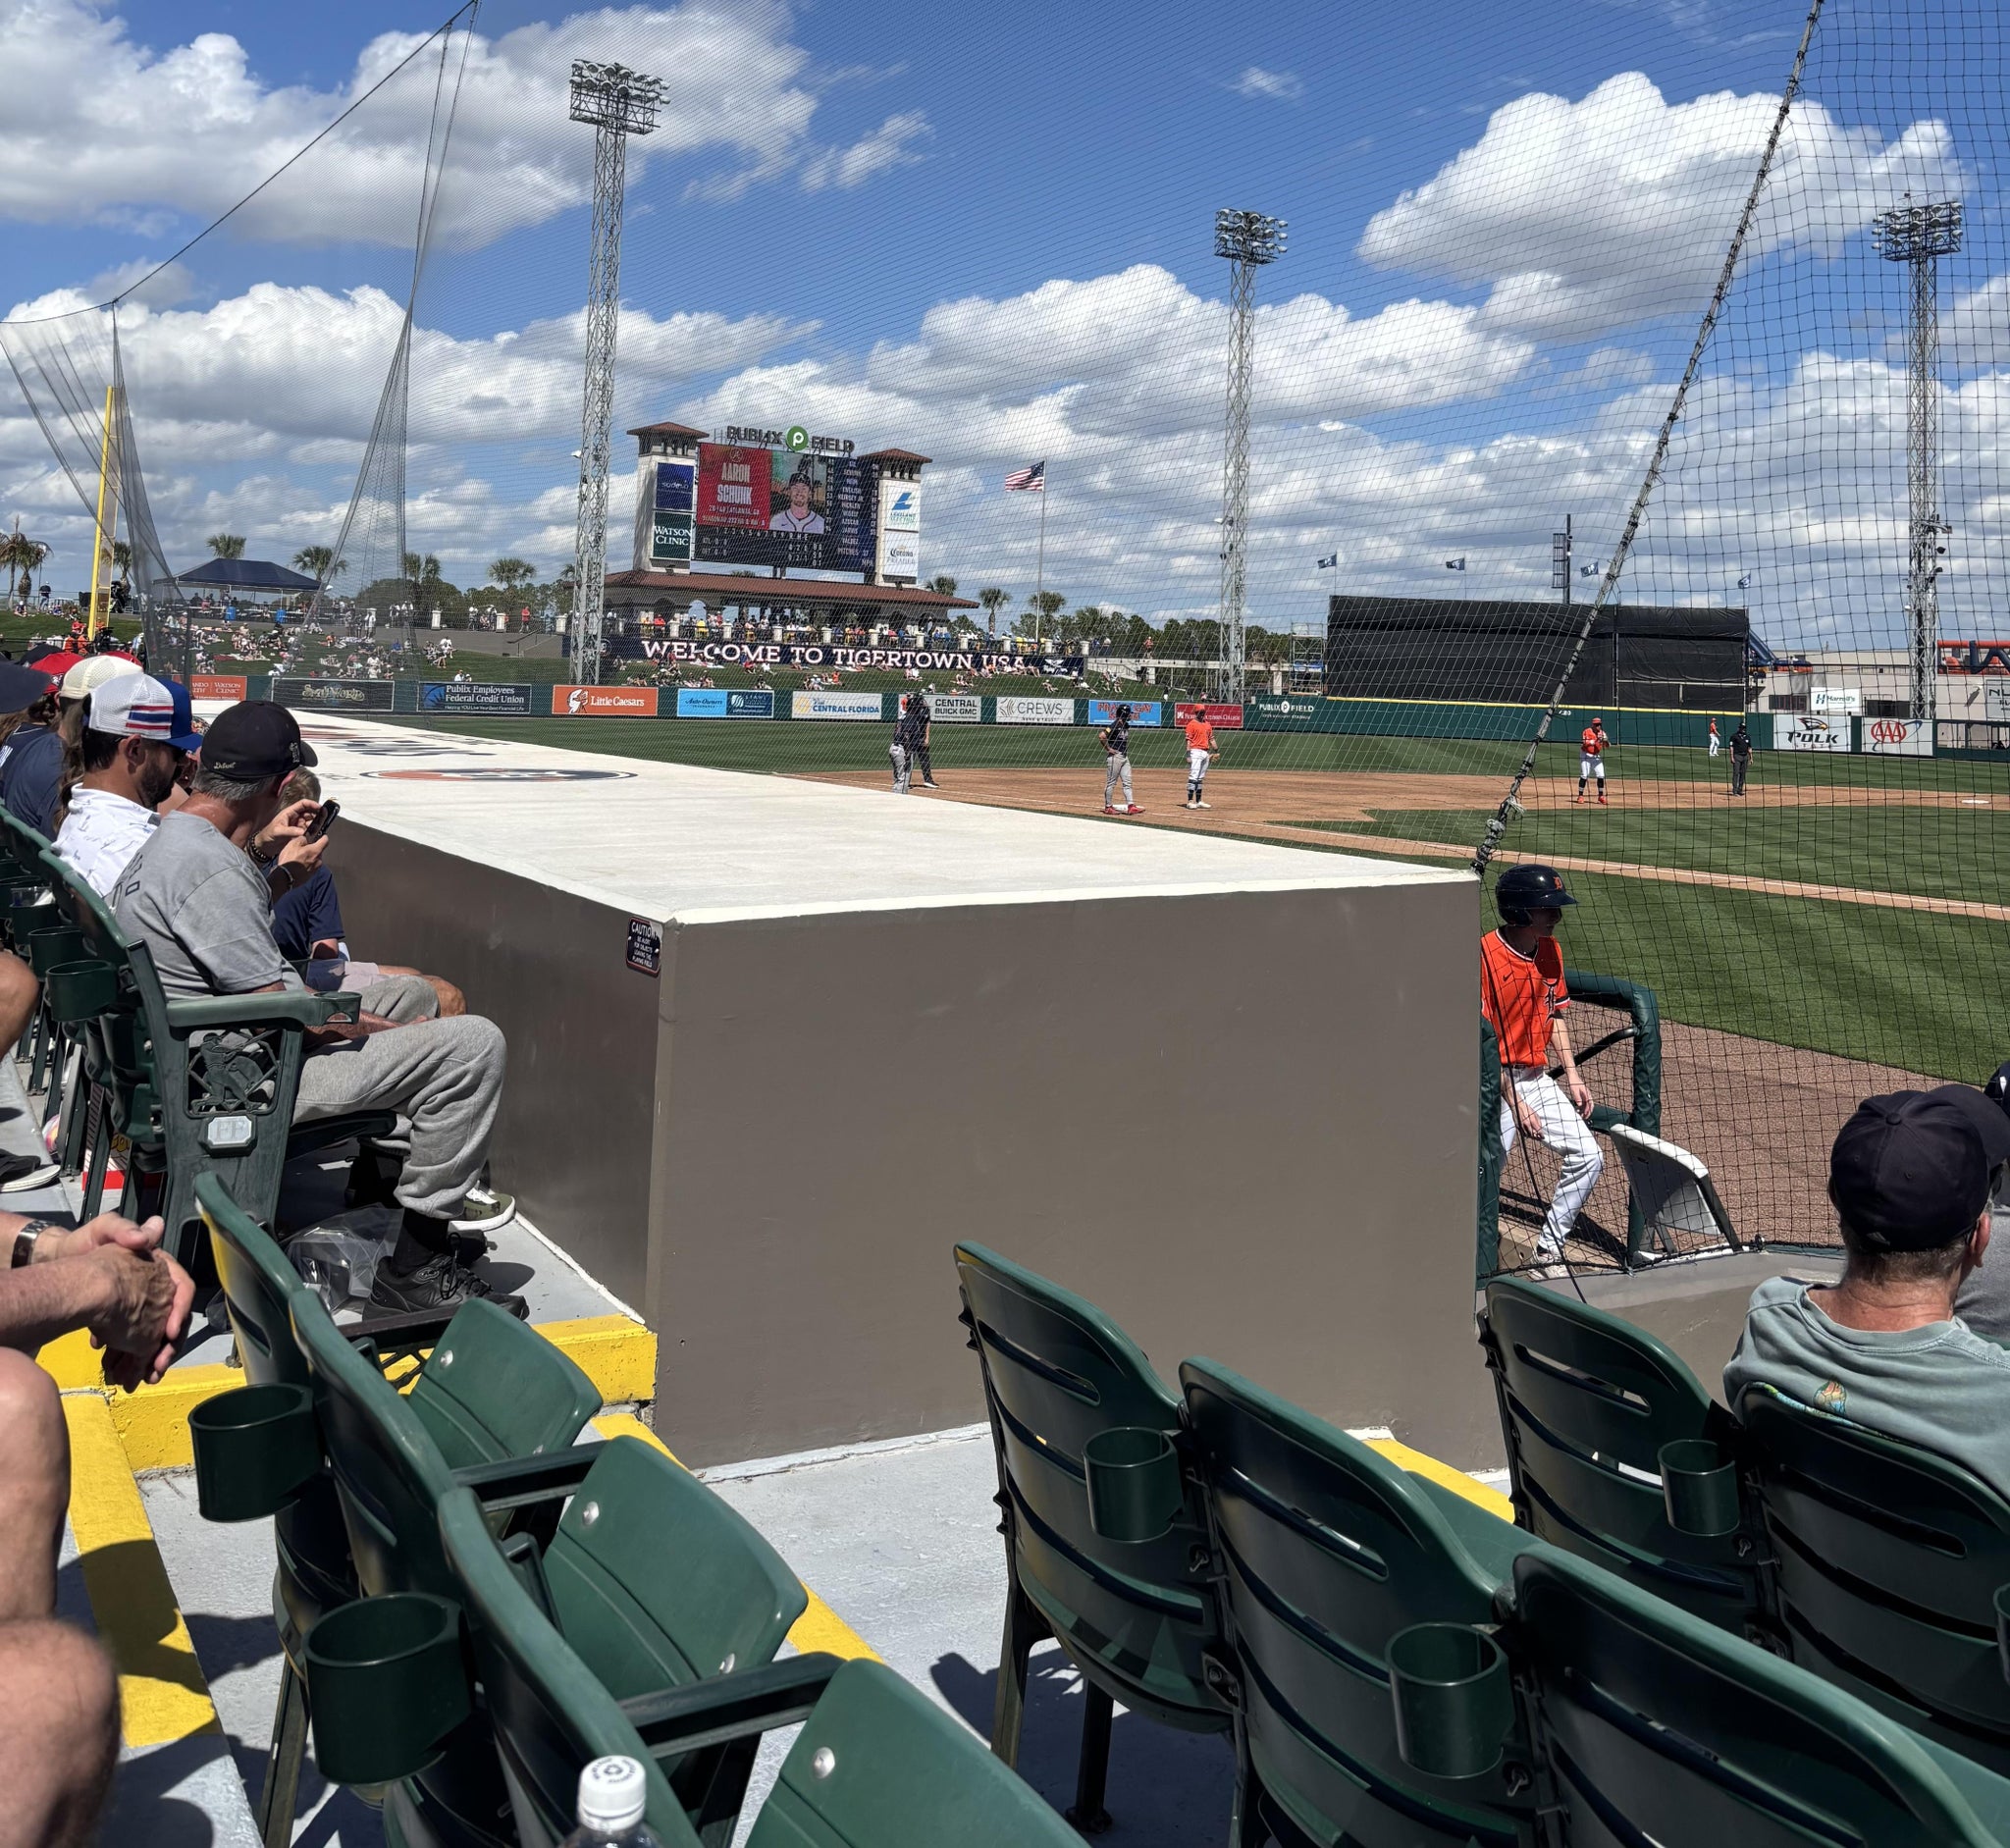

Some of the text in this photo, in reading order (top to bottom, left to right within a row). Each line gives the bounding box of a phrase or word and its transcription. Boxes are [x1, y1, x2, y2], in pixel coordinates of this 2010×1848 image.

[726, 425, 783, 445] PUBLIX
[811, 436, 855, 452] FIELD
[721, 462, 751, 483] AARON
[717, 484, 753, 505] SCHUNK
[654, 525, 692, 536] WATSON
[656, 535, 689, 546] CLINIC
[641, 640, 1025, 669] WELCOME TO TIGERTOWN USA
[472, 686, 515, 696] Employees
[445, 694, 475, 703] Federal
[590, 696, 645, 708] Little Caesars
[934, 698, 978, 708] CENTRAL
[1017, 702, 1063, 715] CREWS
[1259, 703, 1281, 712] PUBLIX
[1786, 731, 1839, 744] POLK
[1874, 720, 1902, 744] AAA
